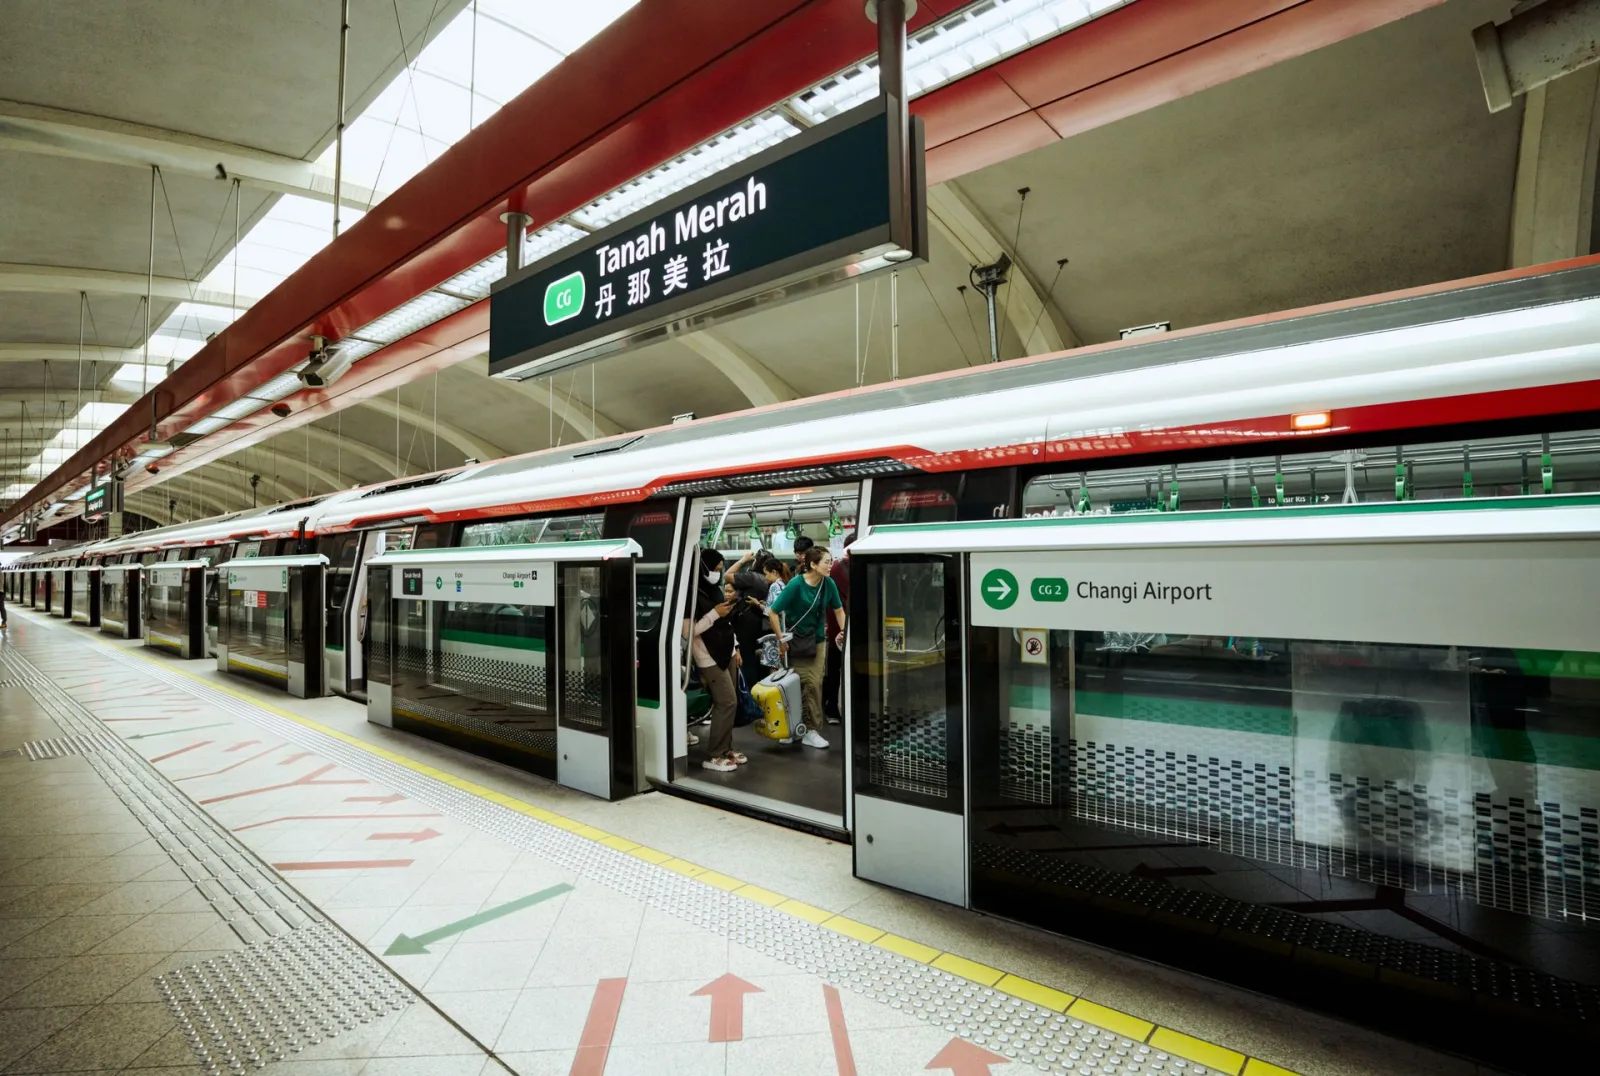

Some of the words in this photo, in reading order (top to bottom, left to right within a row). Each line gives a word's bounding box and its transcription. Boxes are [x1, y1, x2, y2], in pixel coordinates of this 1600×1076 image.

[596, 221, 666, 277] Tanah
[675, 175, 767, 245] Merah
[595, 238, 731, 319] 丹那美拉
[556, 288, 572, 309] CG
[503, 572, 516, 580] Changi
[517, 572, 531, 580] Airport
[1038, 584, 1052, 595] CG
[1055, 585, 1062, 595] 2
[1076, 581, 1138, 603] Changi
[1143, 582, 1213, 604] Airport
